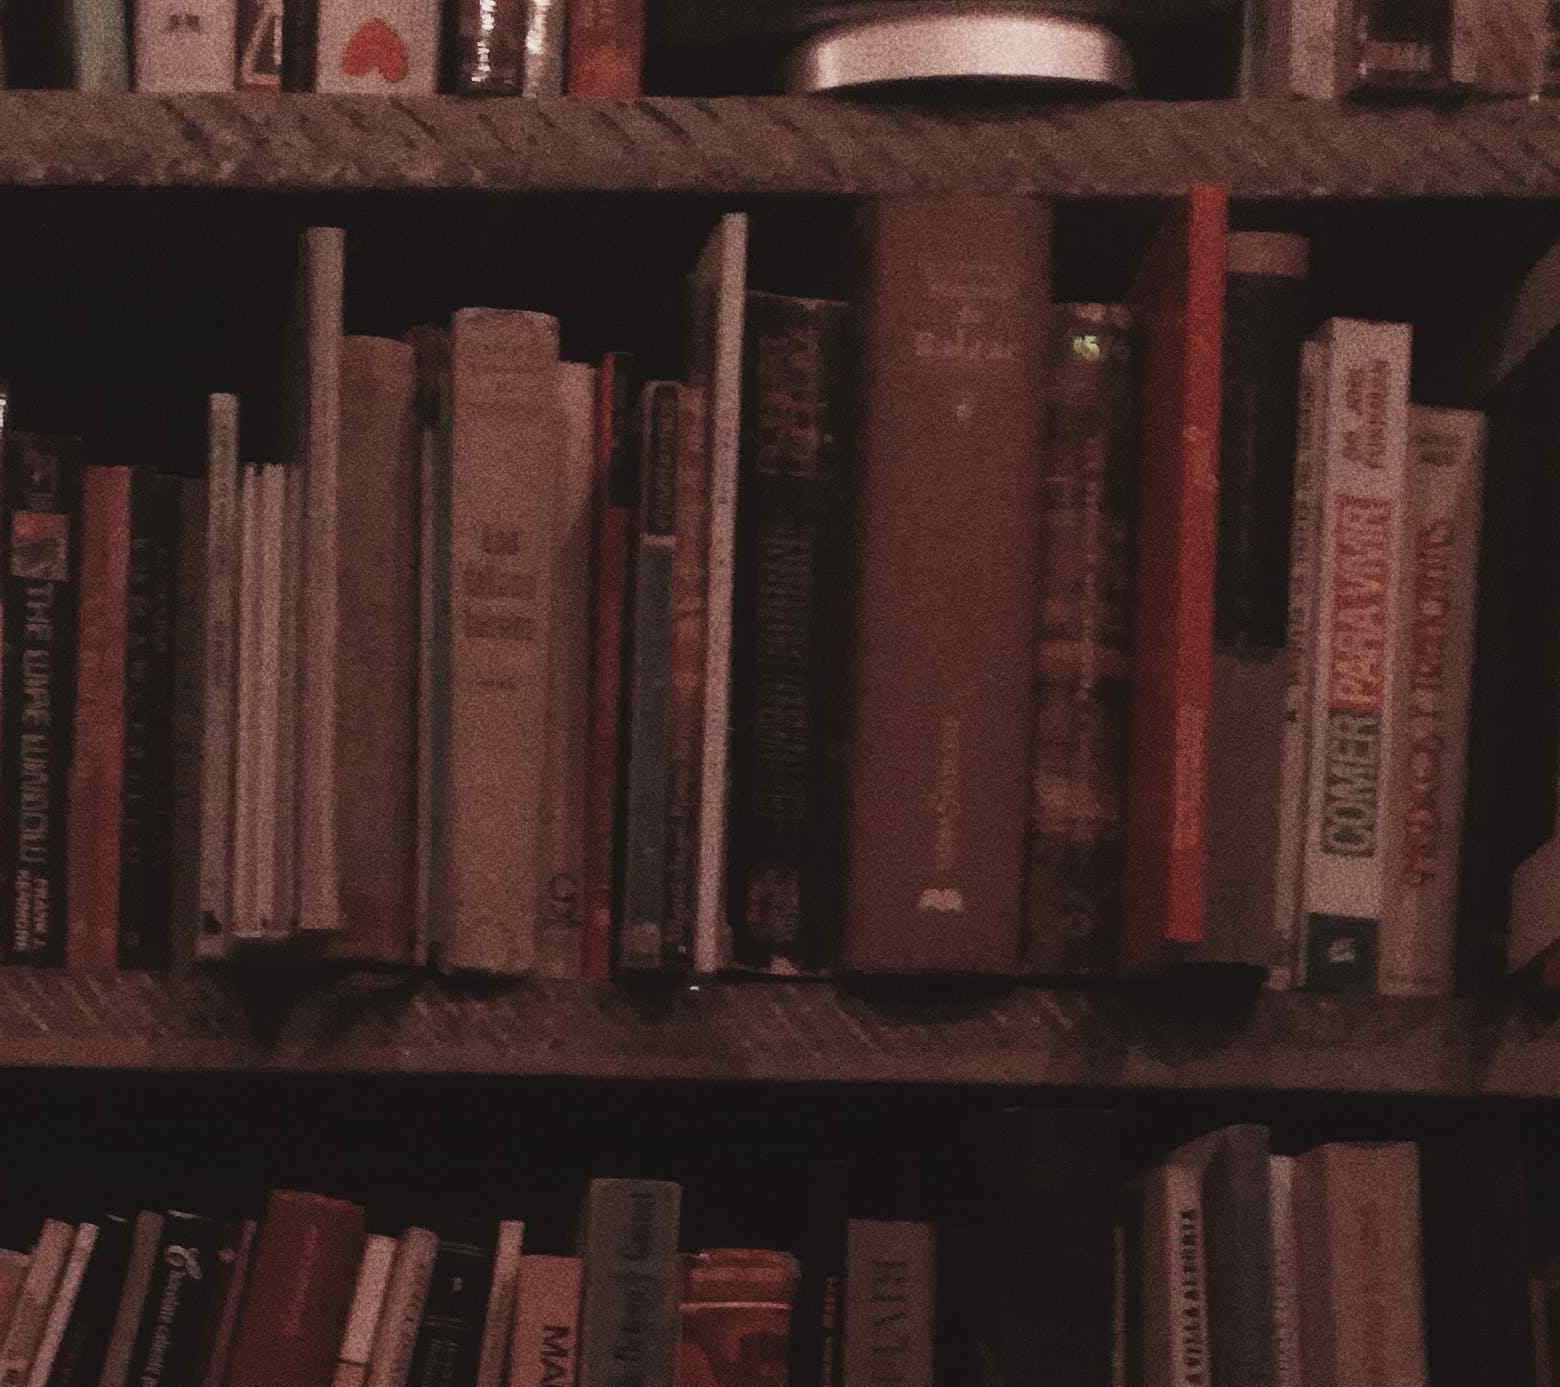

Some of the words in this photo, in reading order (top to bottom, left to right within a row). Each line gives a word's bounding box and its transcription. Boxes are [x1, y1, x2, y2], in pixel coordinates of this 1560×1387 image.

[1336, 499, 1390, 600] VIVIR
[1330, 605, 1383, 704] PARA
[1324, 713, 1377, 854] COMER
[1182, 1307, 1204, 1369] VILLA
